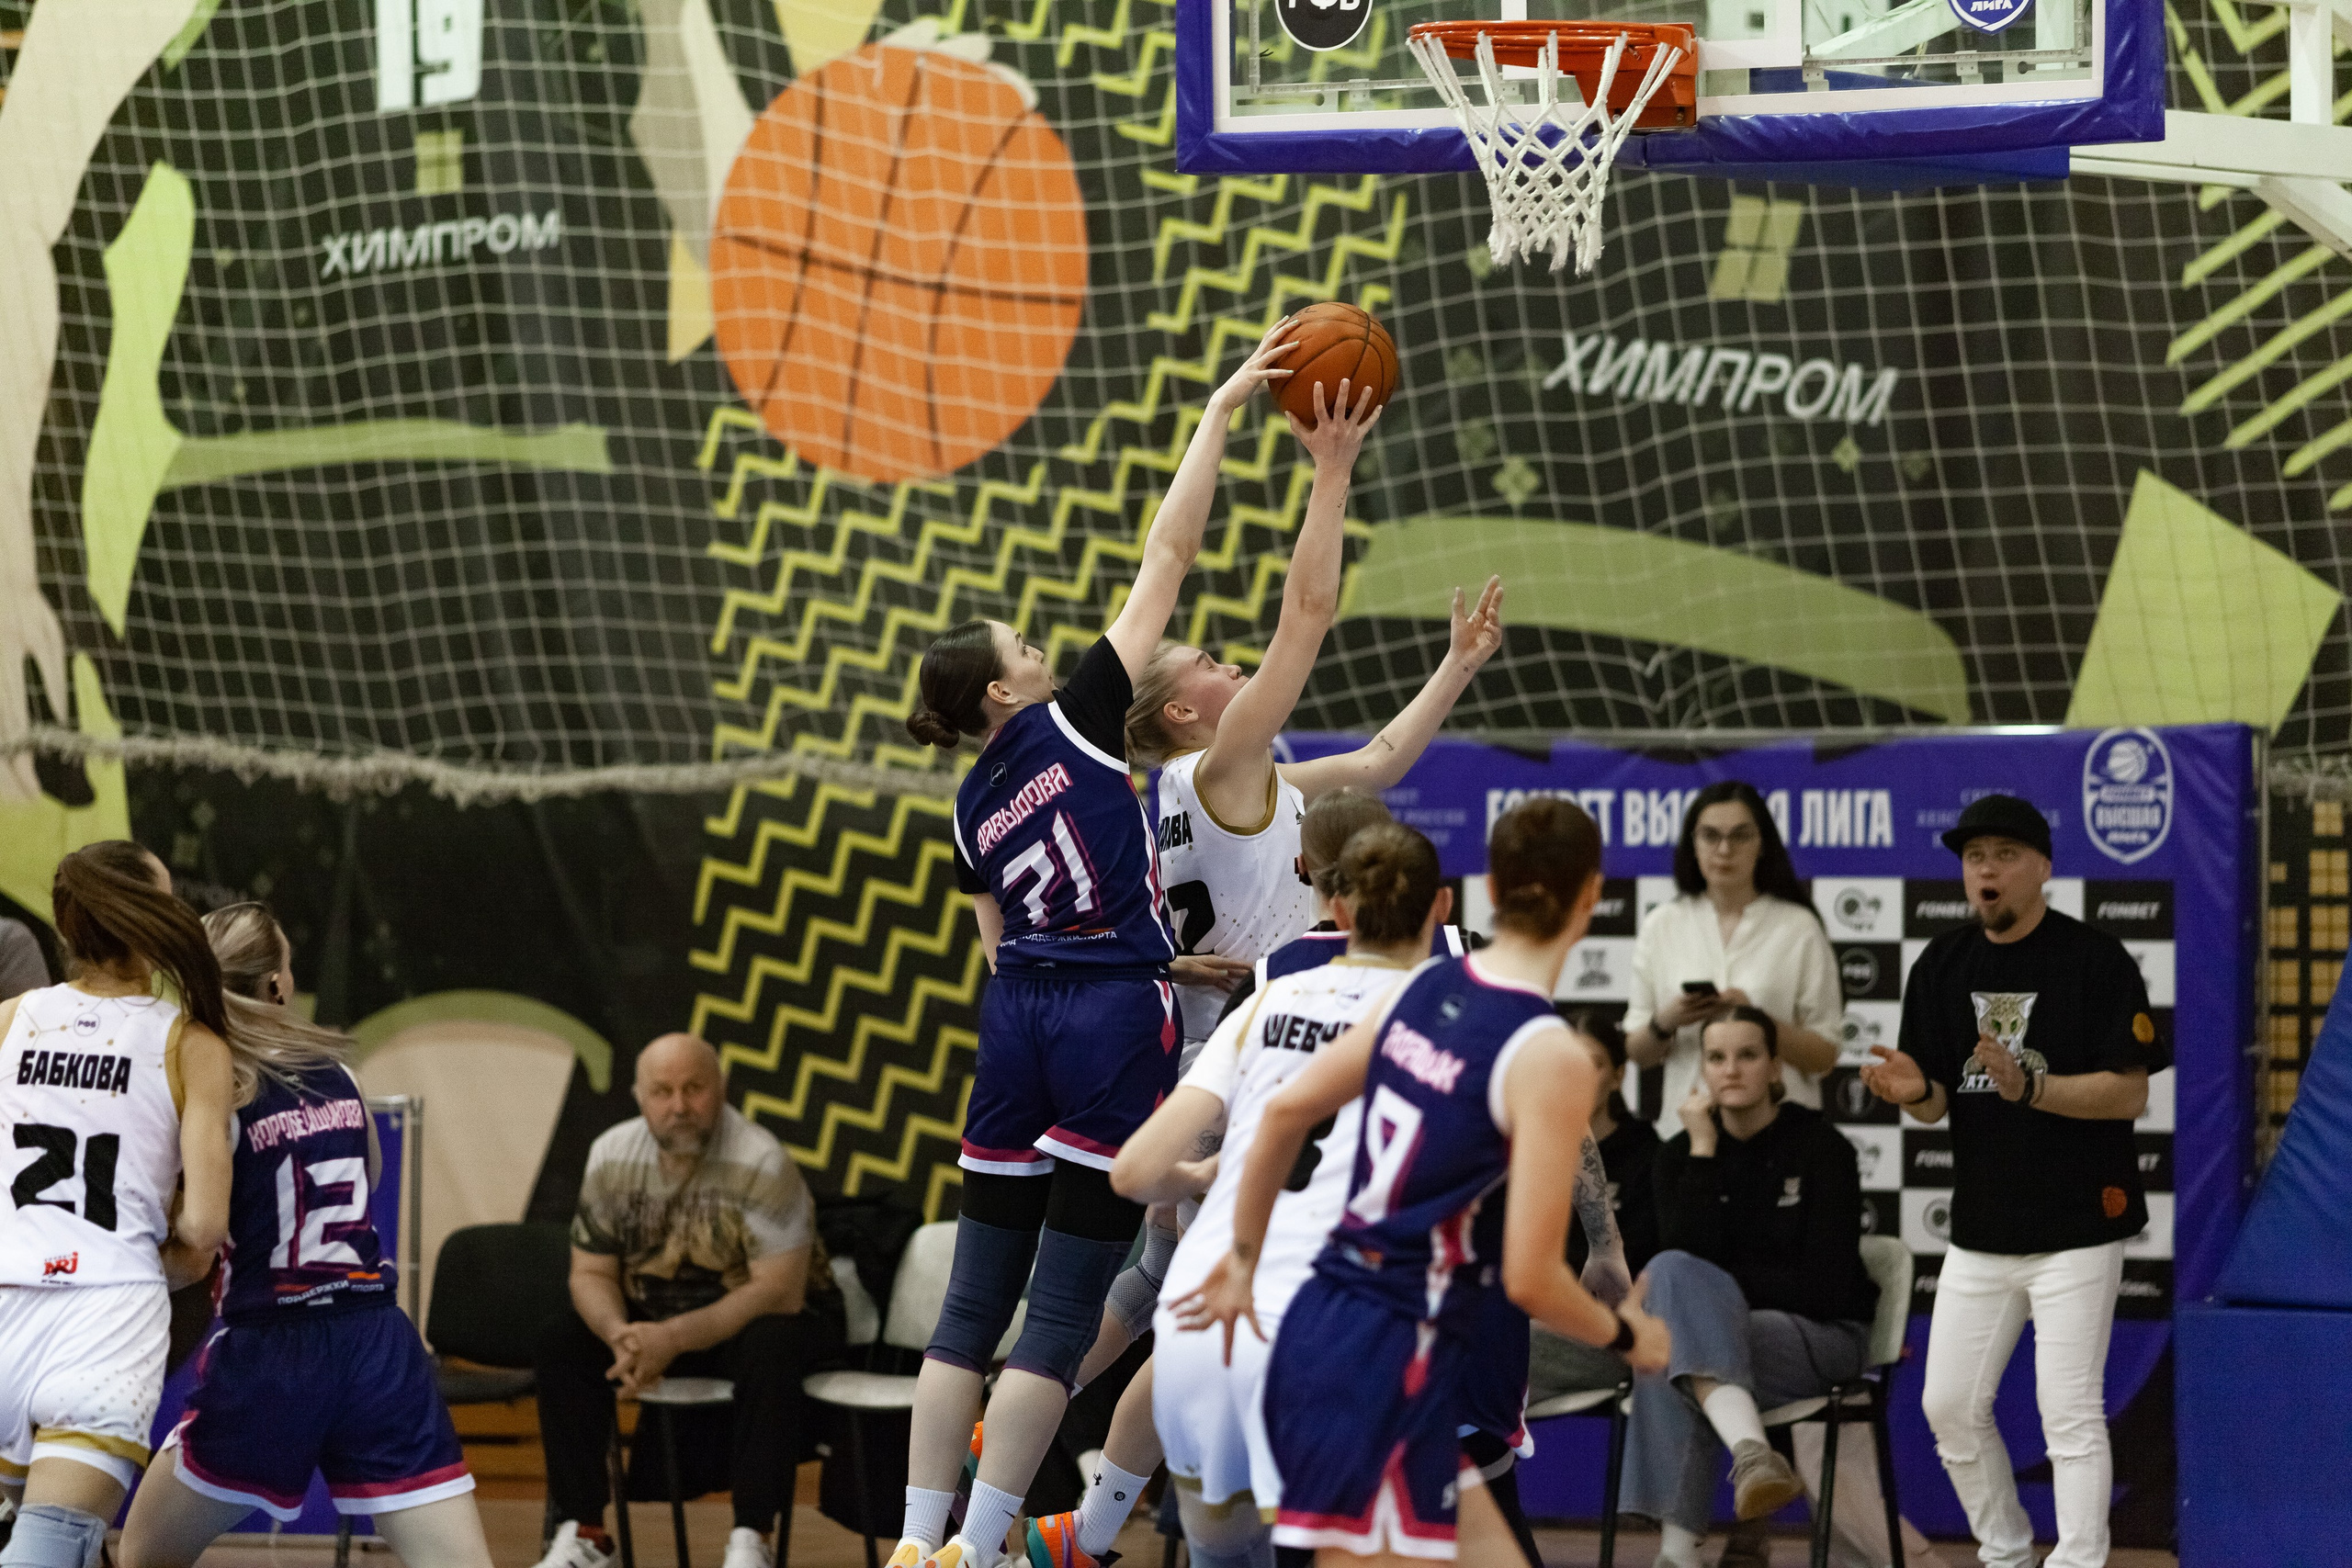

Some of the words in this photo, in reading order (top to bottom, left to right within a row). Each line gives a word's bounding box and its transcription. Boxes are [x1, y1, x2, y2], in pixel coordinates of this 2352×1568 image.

[1970, 0, 2014, 12] ЛИГА
[322, 209, 560, 277] ХИМПРОМ
[1543, 332, 1899, 427] ХИМПРОМ
[1798, 789, 1894, 848] ЛИГА
[1002, 810, 1098, 925] 71
[17, 1050, 131, 1094] БАБКОВА
[10, 1122, 120, 1233] 21
[1347, 1084, 1423, 1224] 9
[269, 1153, 368, 1269] 12
